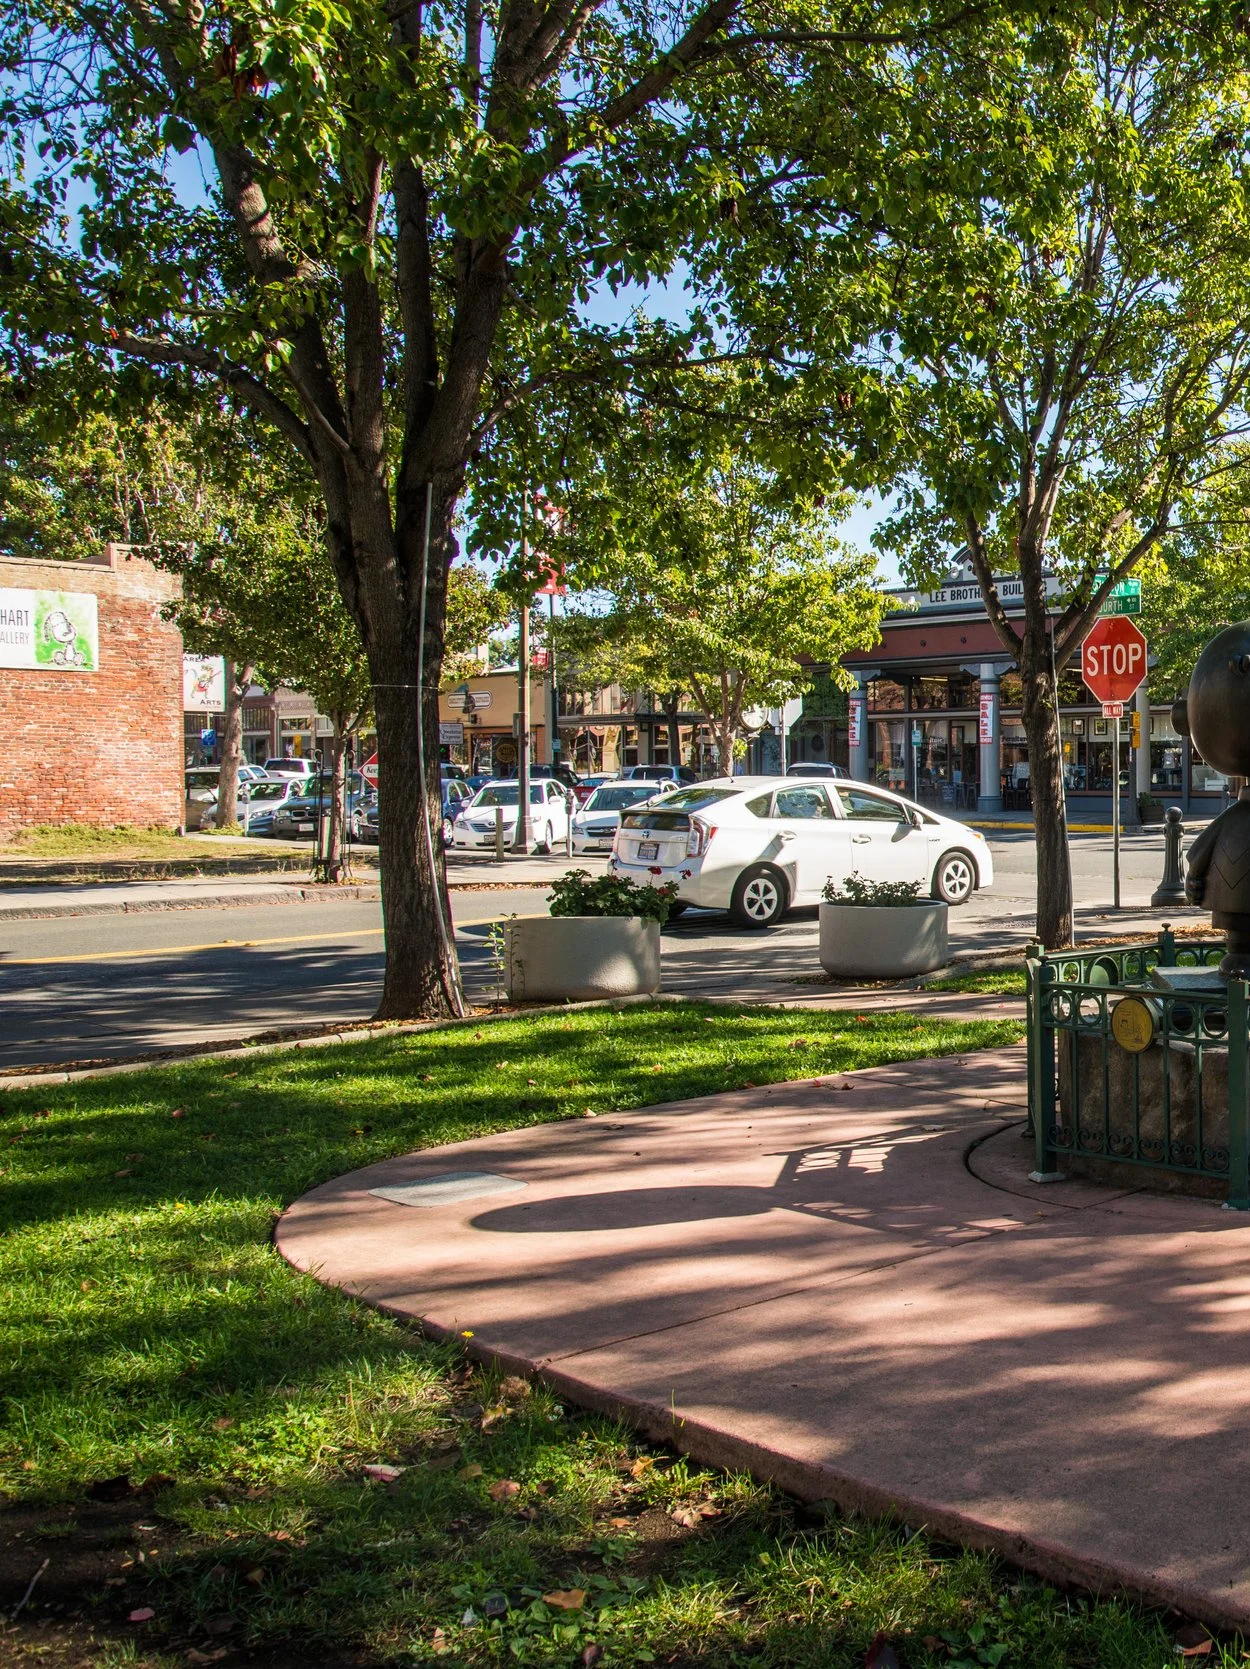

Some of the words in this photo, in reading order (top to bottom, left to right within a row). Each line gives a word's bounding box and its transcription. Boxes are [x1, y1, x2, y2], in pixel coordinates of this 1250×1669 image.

[929, 590, 946, 603] LEE
[950, 587, 984, 601] BROTH
[1002, 582, 1024, 596] BUIL
[1100, 600, 1123, 613] URTH
[1086, 643, 1142, 677] STOP
[980, 702, 989, 735] SALE
[1104, 706, 1112, 716] ALL
[1112, 705, 1121, 714] WAY
